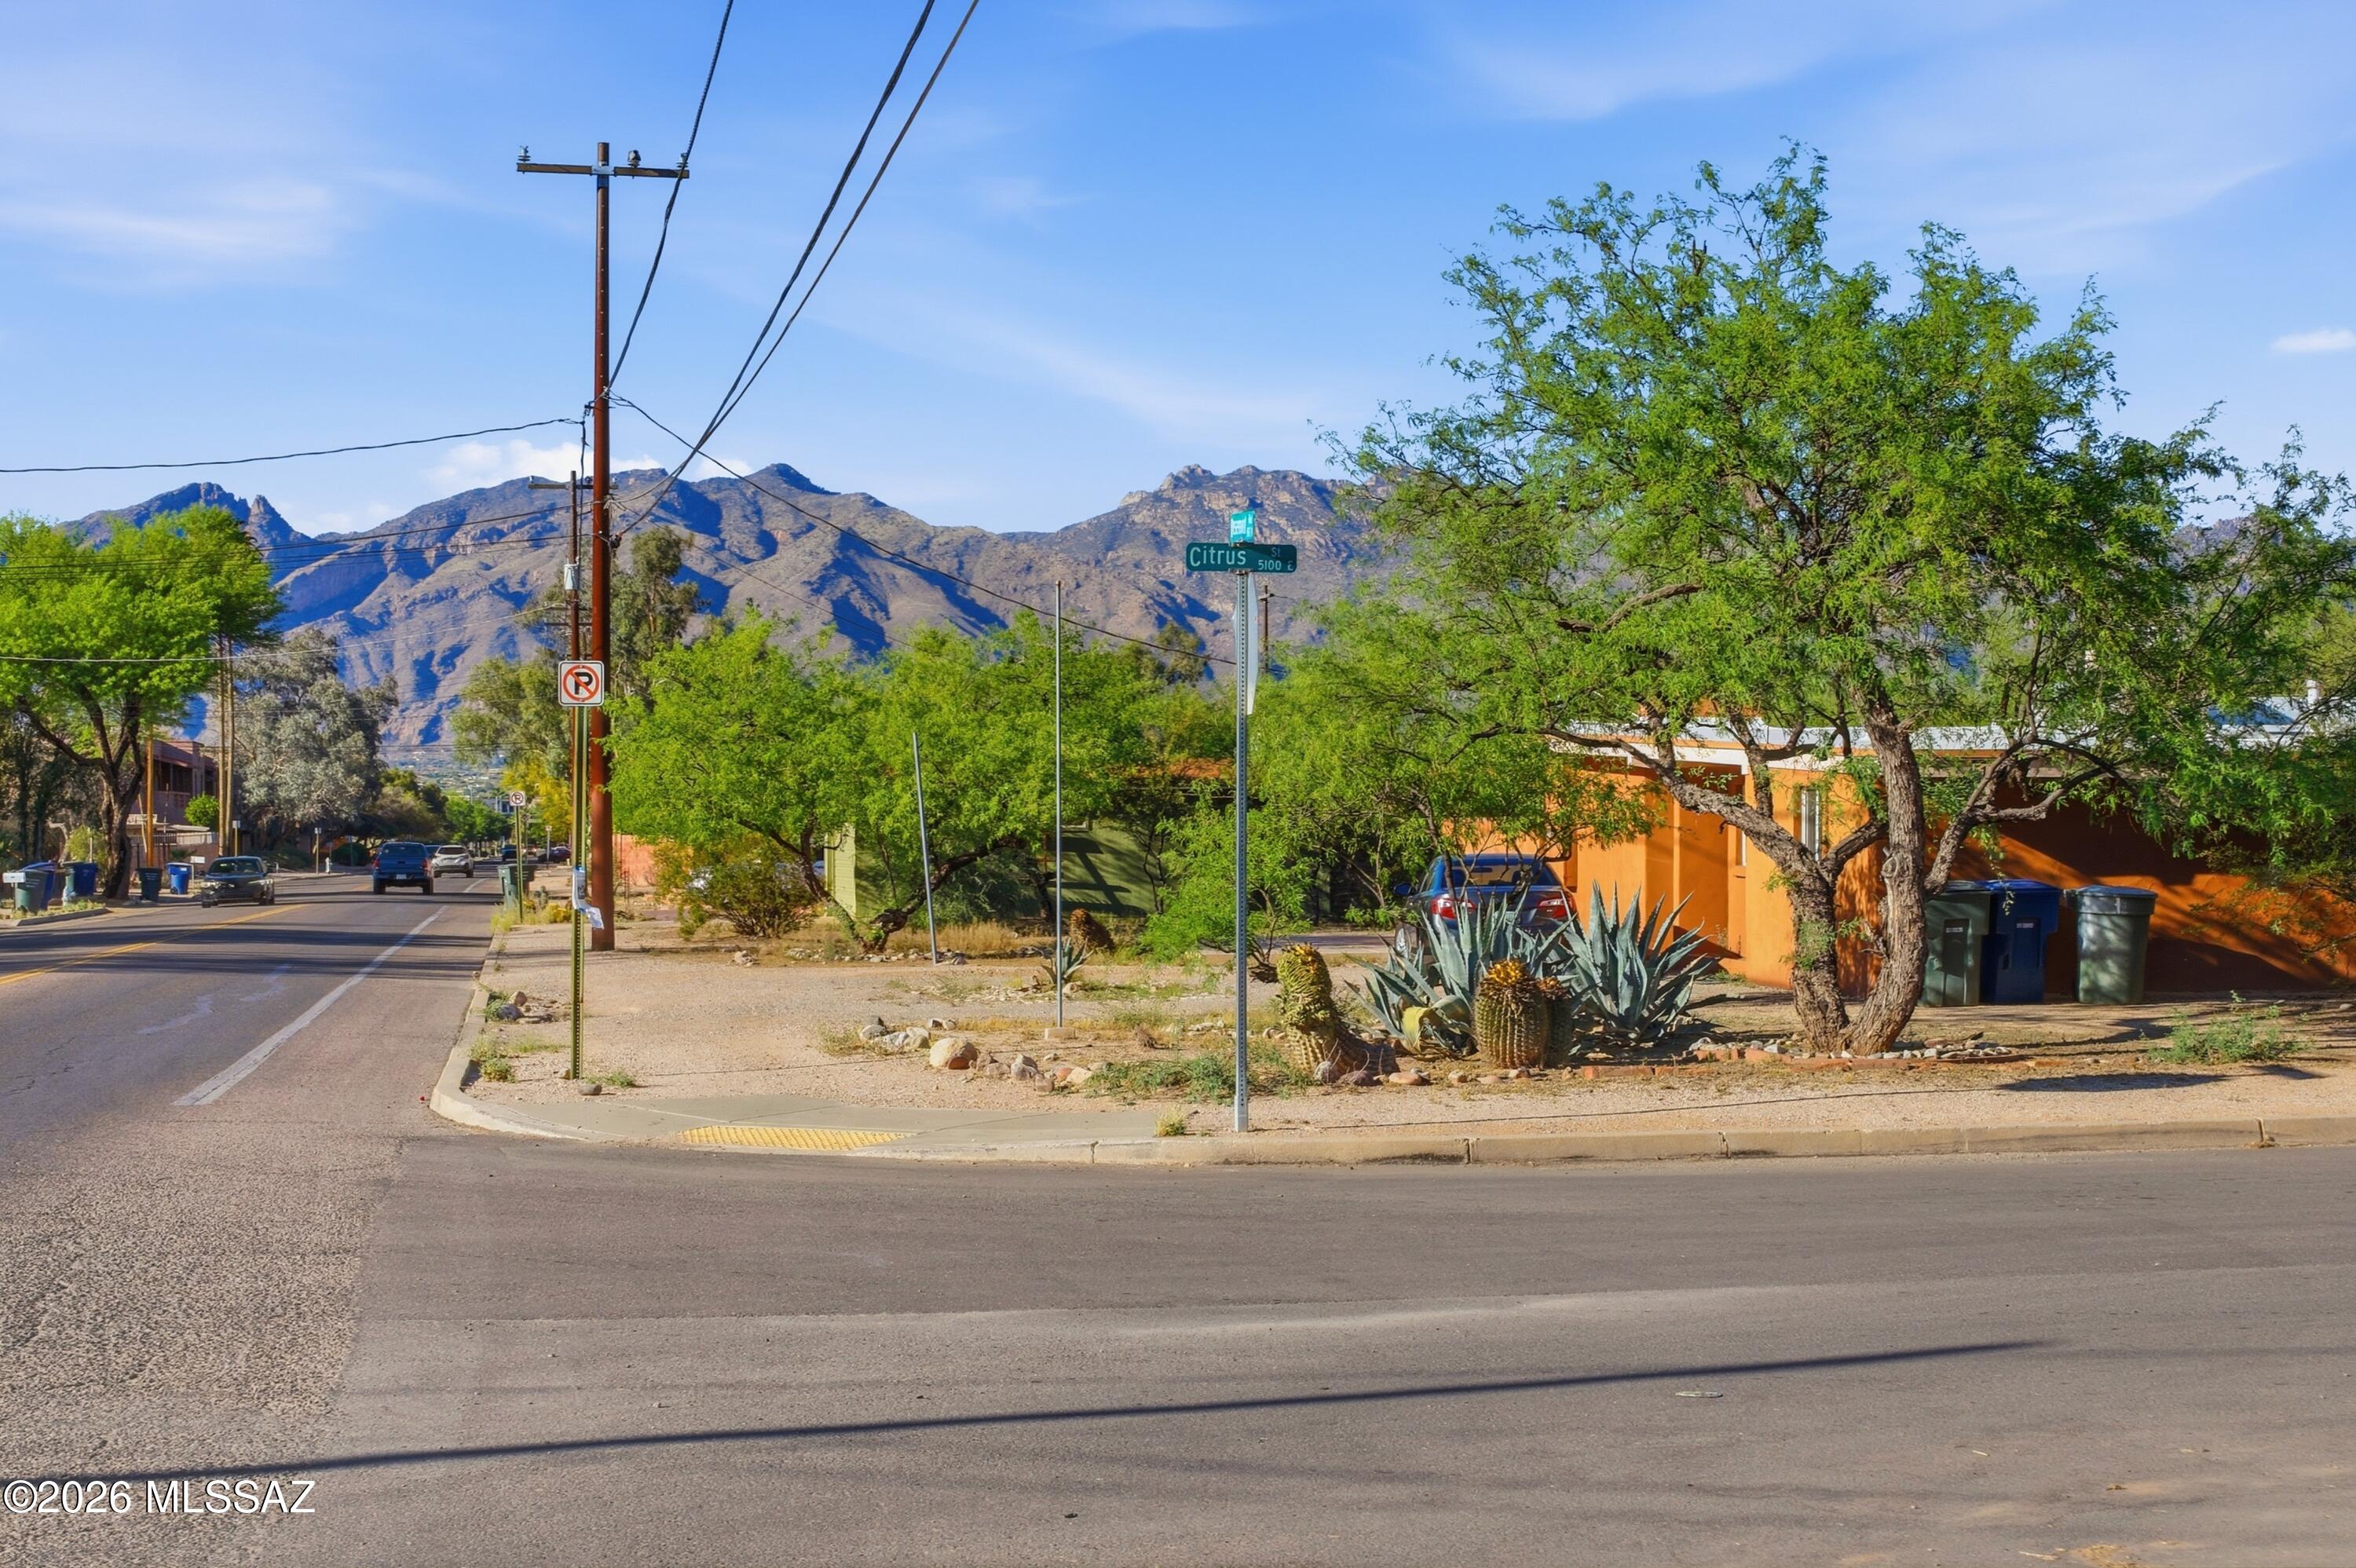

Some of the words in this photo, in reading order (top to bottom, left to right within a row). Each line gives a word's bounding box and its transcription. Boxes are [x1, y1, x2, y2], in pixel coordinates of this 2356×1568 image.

[1190, 546, 1246, 567] Citrus
[1271, 547, 1281, 557] St
[1257, 559, 1282, 571] 5100
